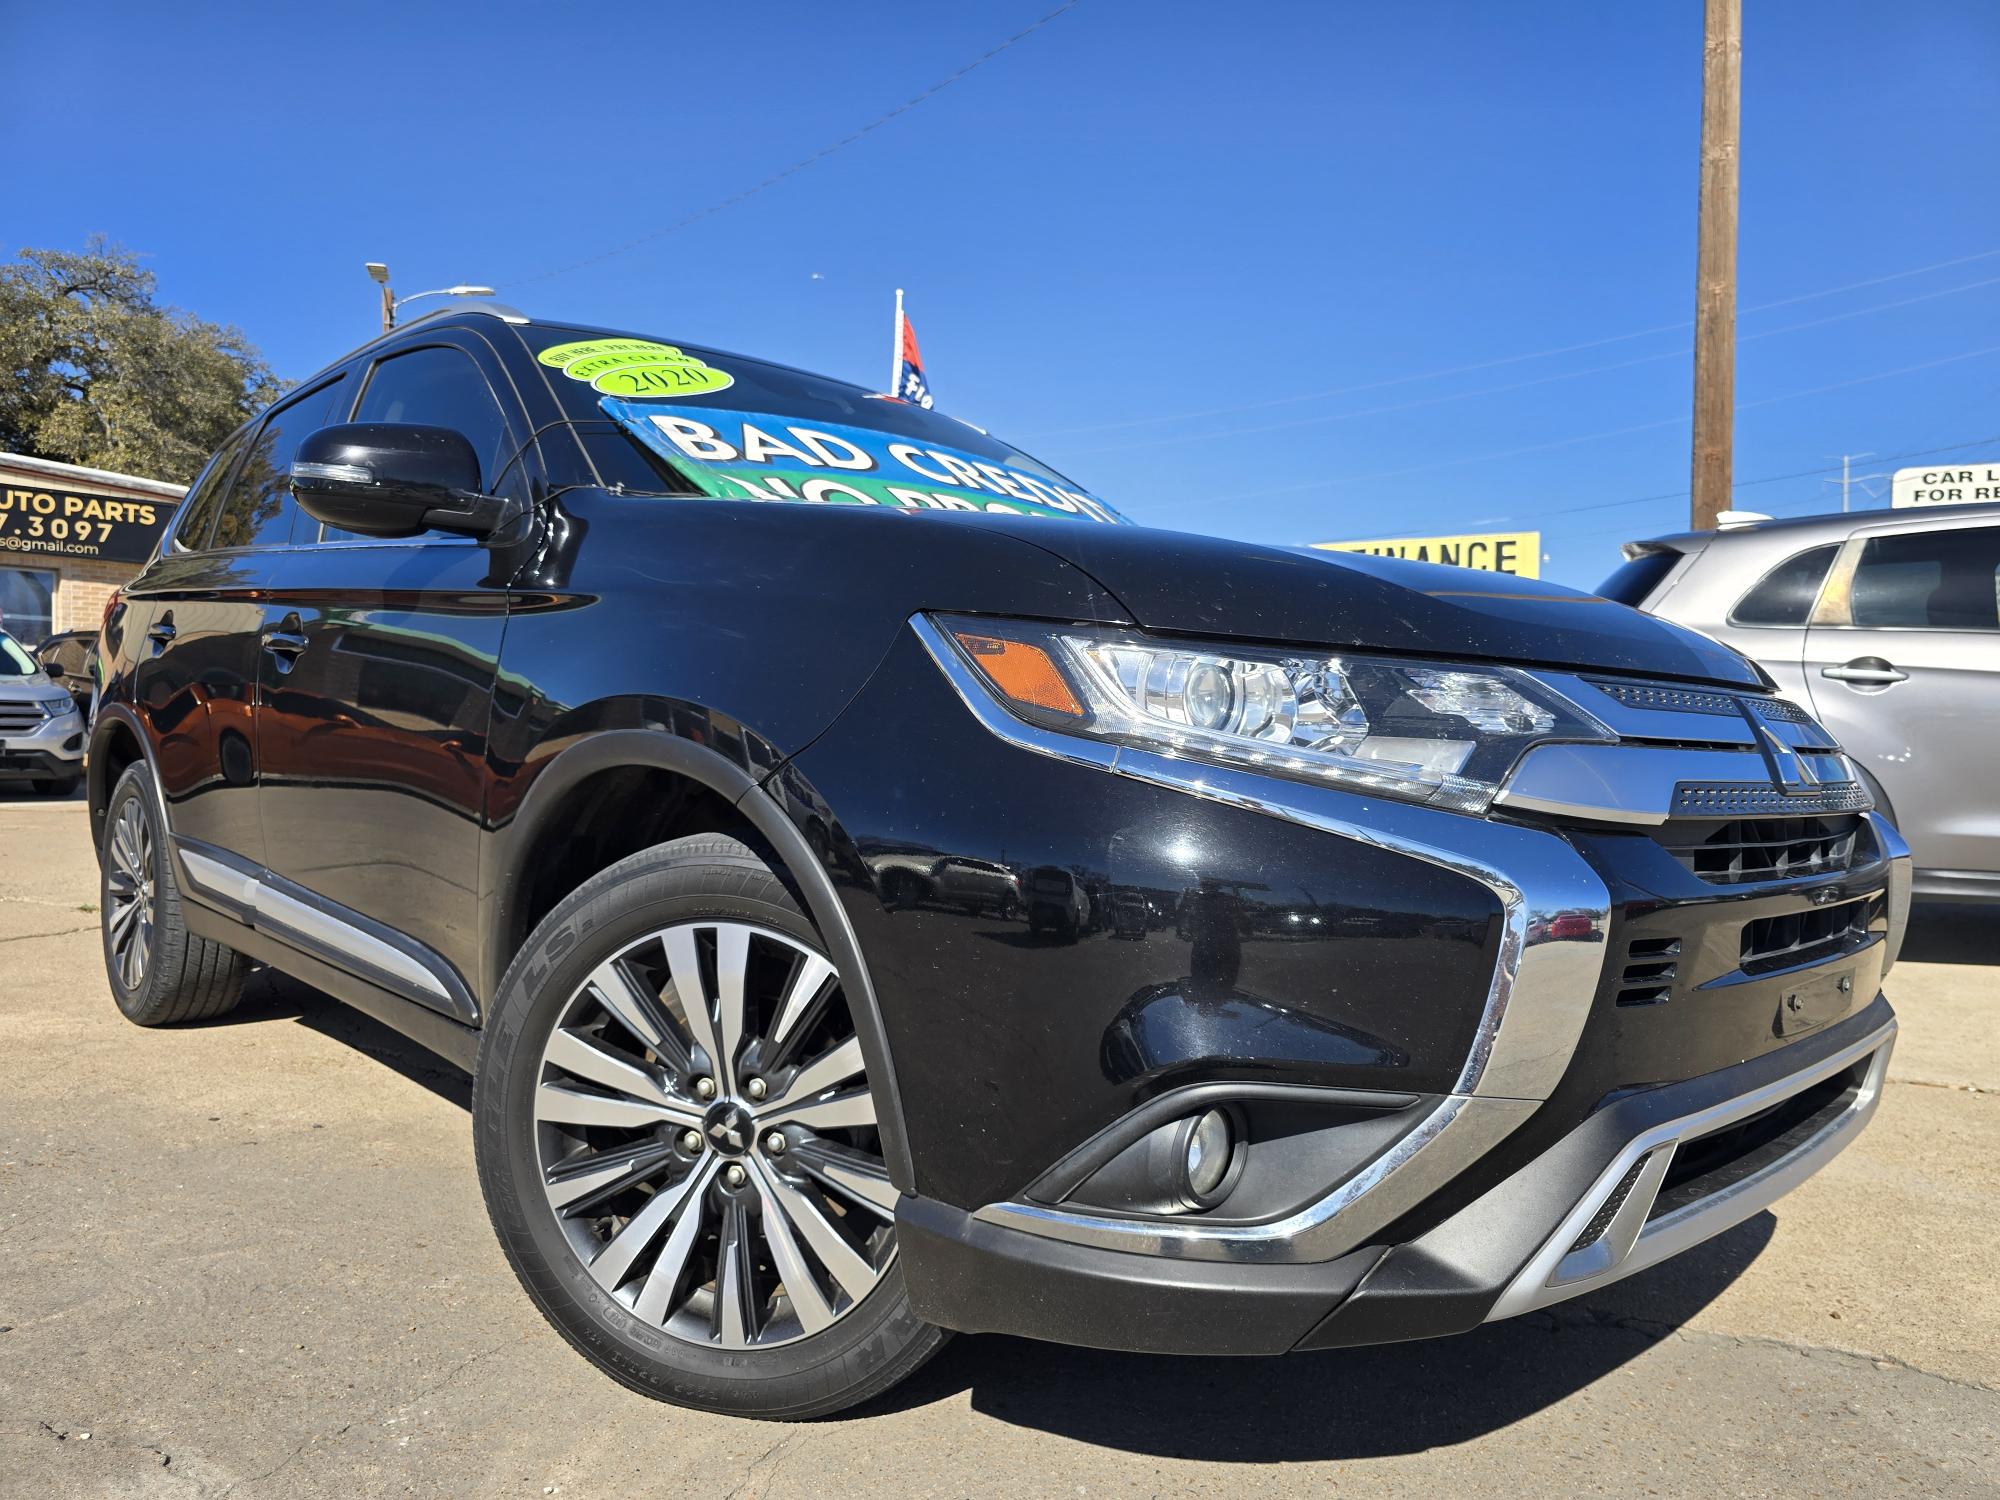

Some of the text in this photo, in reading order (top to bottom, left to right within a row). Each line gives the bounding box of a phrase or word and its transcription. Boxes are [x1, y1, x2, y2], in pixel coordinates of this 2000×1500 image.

[575, 357, 623, 377] EXTRA
[619, 367, 708, 392] 2020
[648, 415, 873, 470] BAD
[1922, 471, 1973, 485] CAR
[1914, 488, 1963, 502] FOR
[64, 496, 156, 526] PARTS
